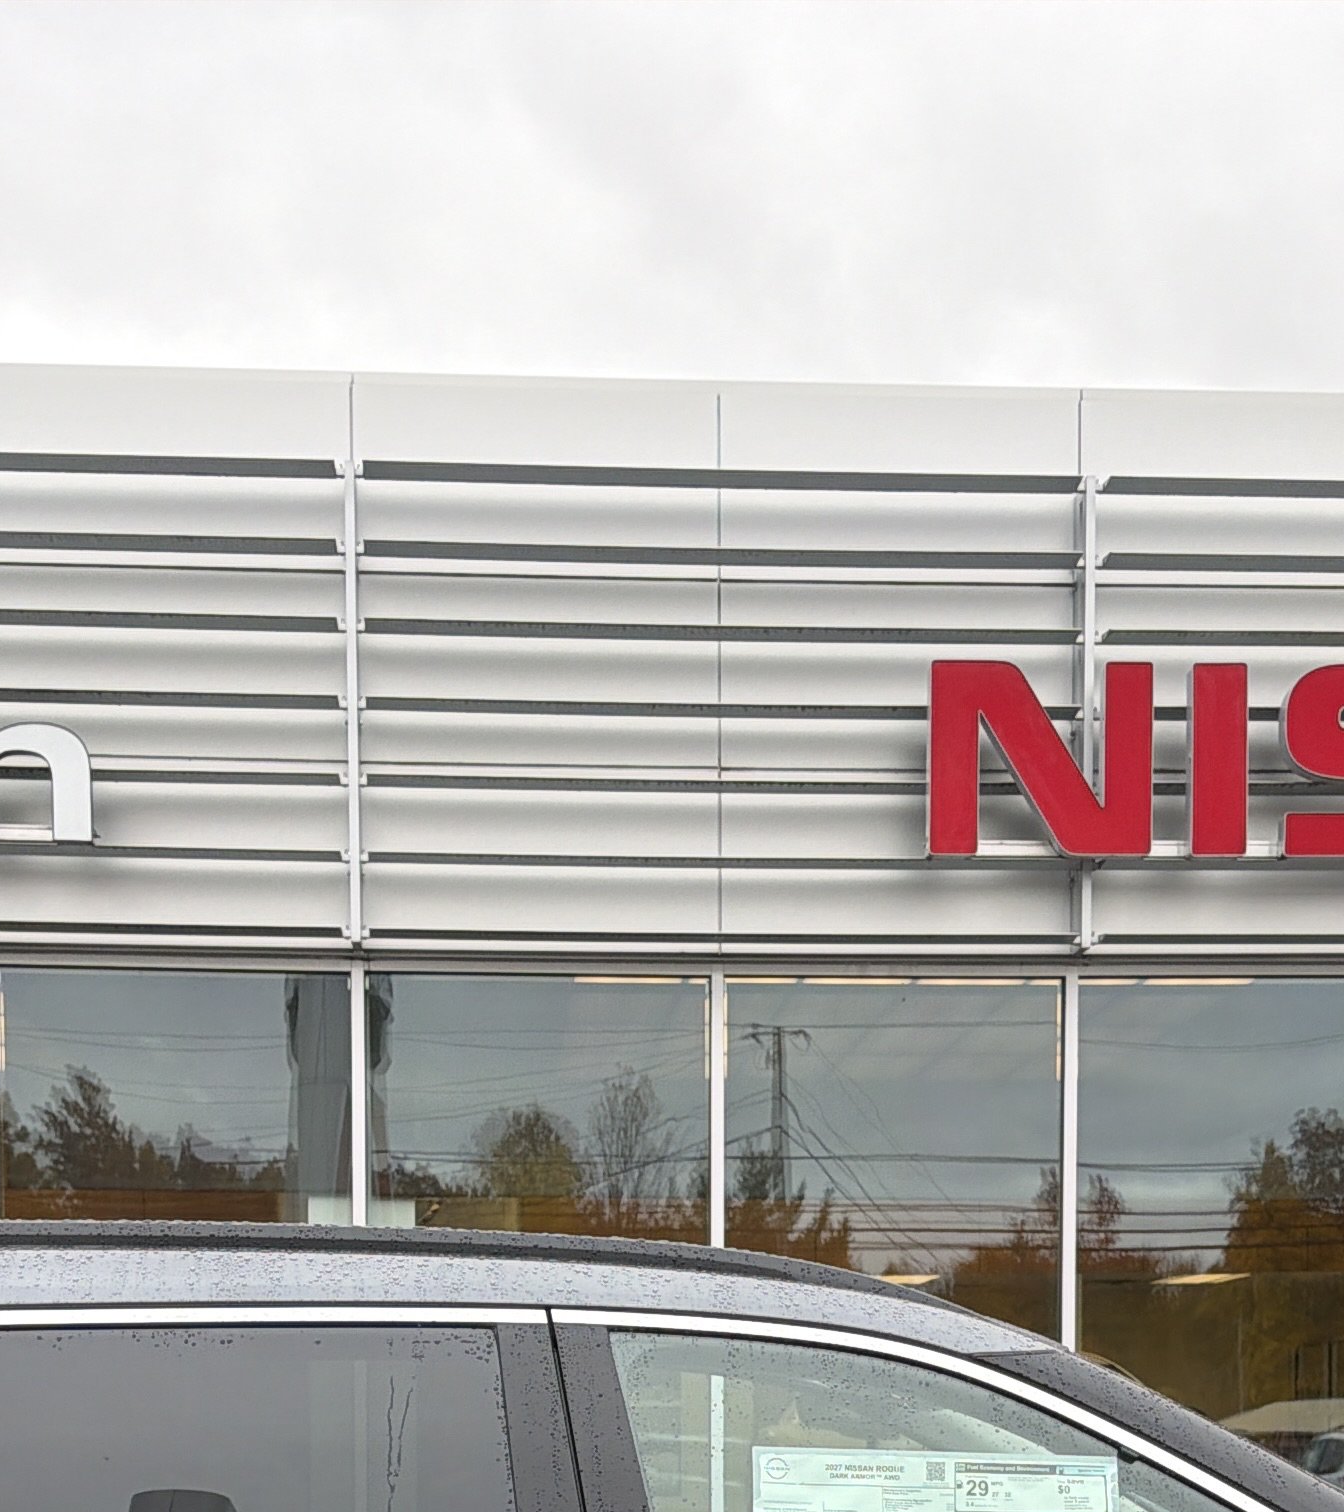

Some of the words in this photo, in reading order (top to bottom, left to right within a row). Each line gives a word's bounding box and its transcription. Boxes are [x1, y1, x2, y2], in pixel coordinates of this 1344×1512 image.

[845, 1464, 874, 1472] NISSAN
[876, 1465, 905, 1473] ROGUE
[966, 1479, 989, 1497] 29
[1058, 1485, 1071, 1495] $0
